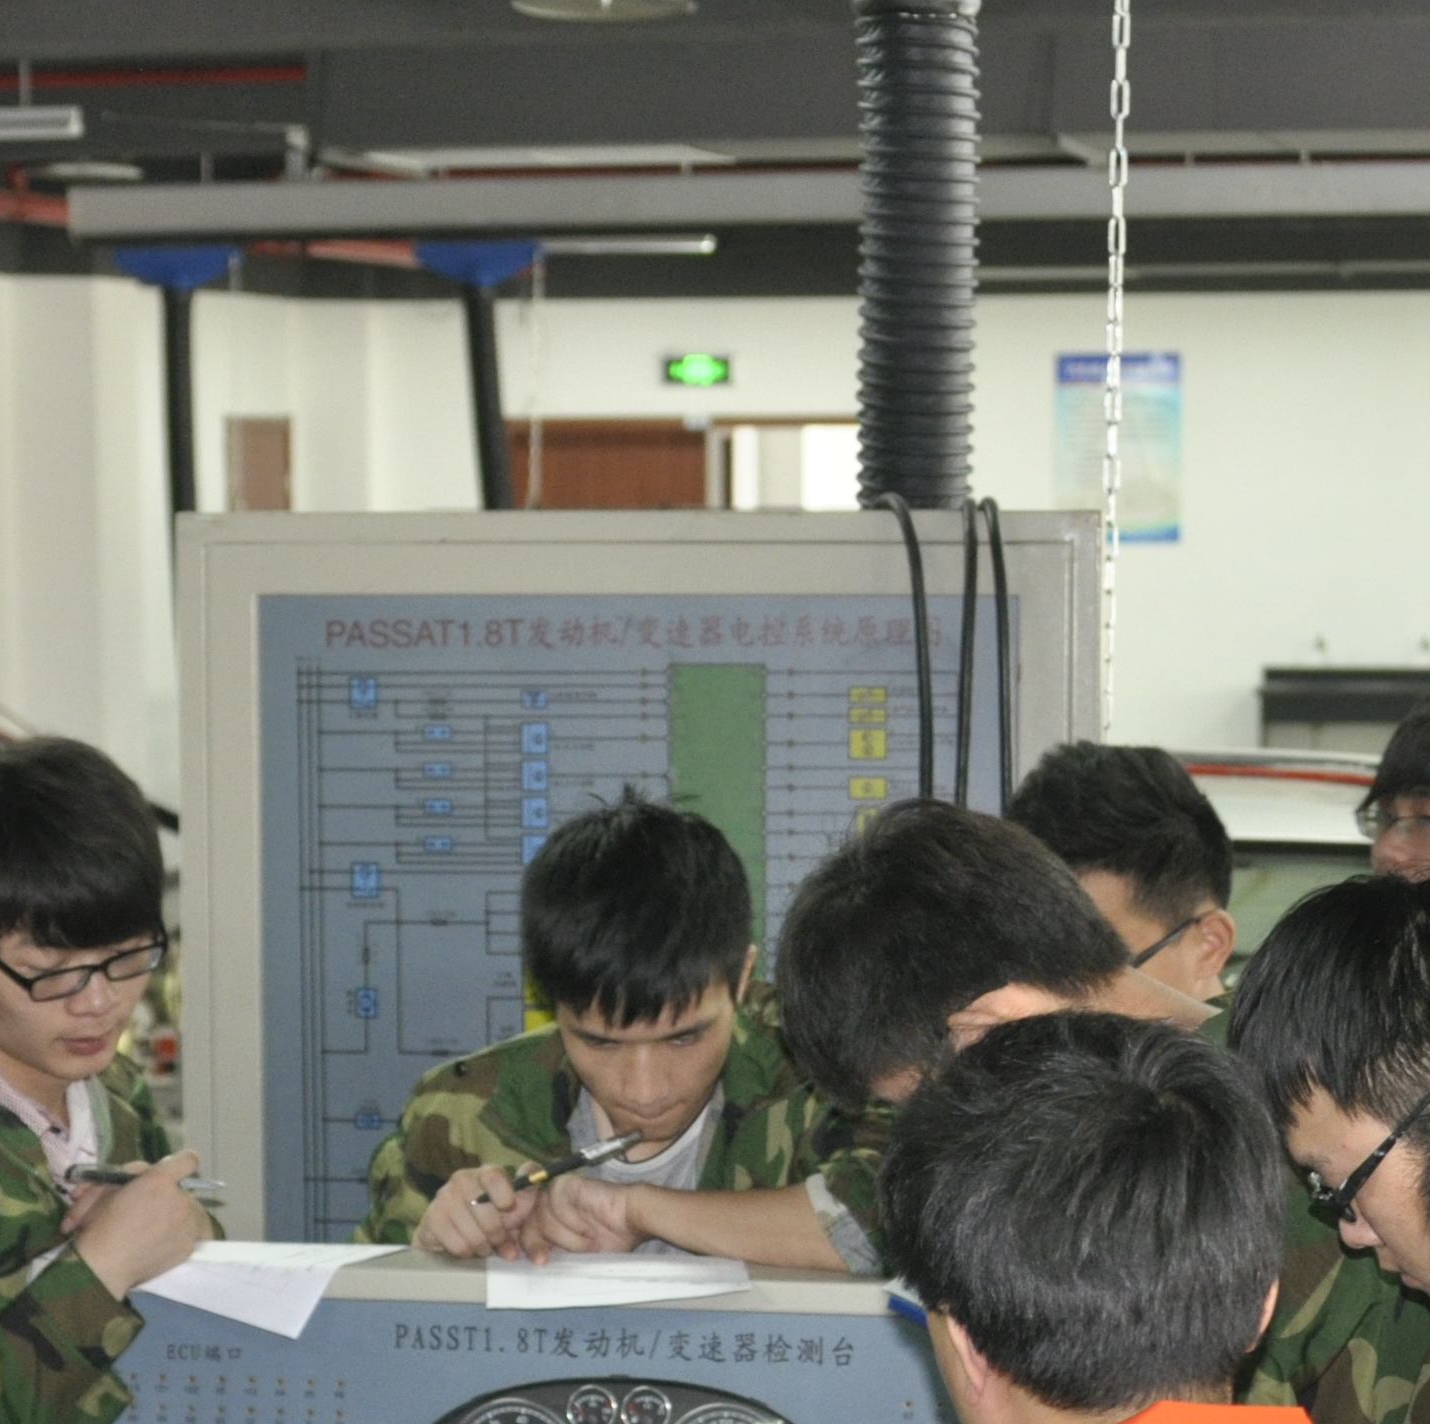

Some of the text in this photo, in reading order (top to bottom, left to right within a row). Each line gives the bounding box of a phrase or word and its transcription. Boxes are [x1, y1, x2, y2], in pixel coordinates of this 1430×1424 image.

[394, 1323, 856, 1367] PASST1.8T发动机/变速器检测台
